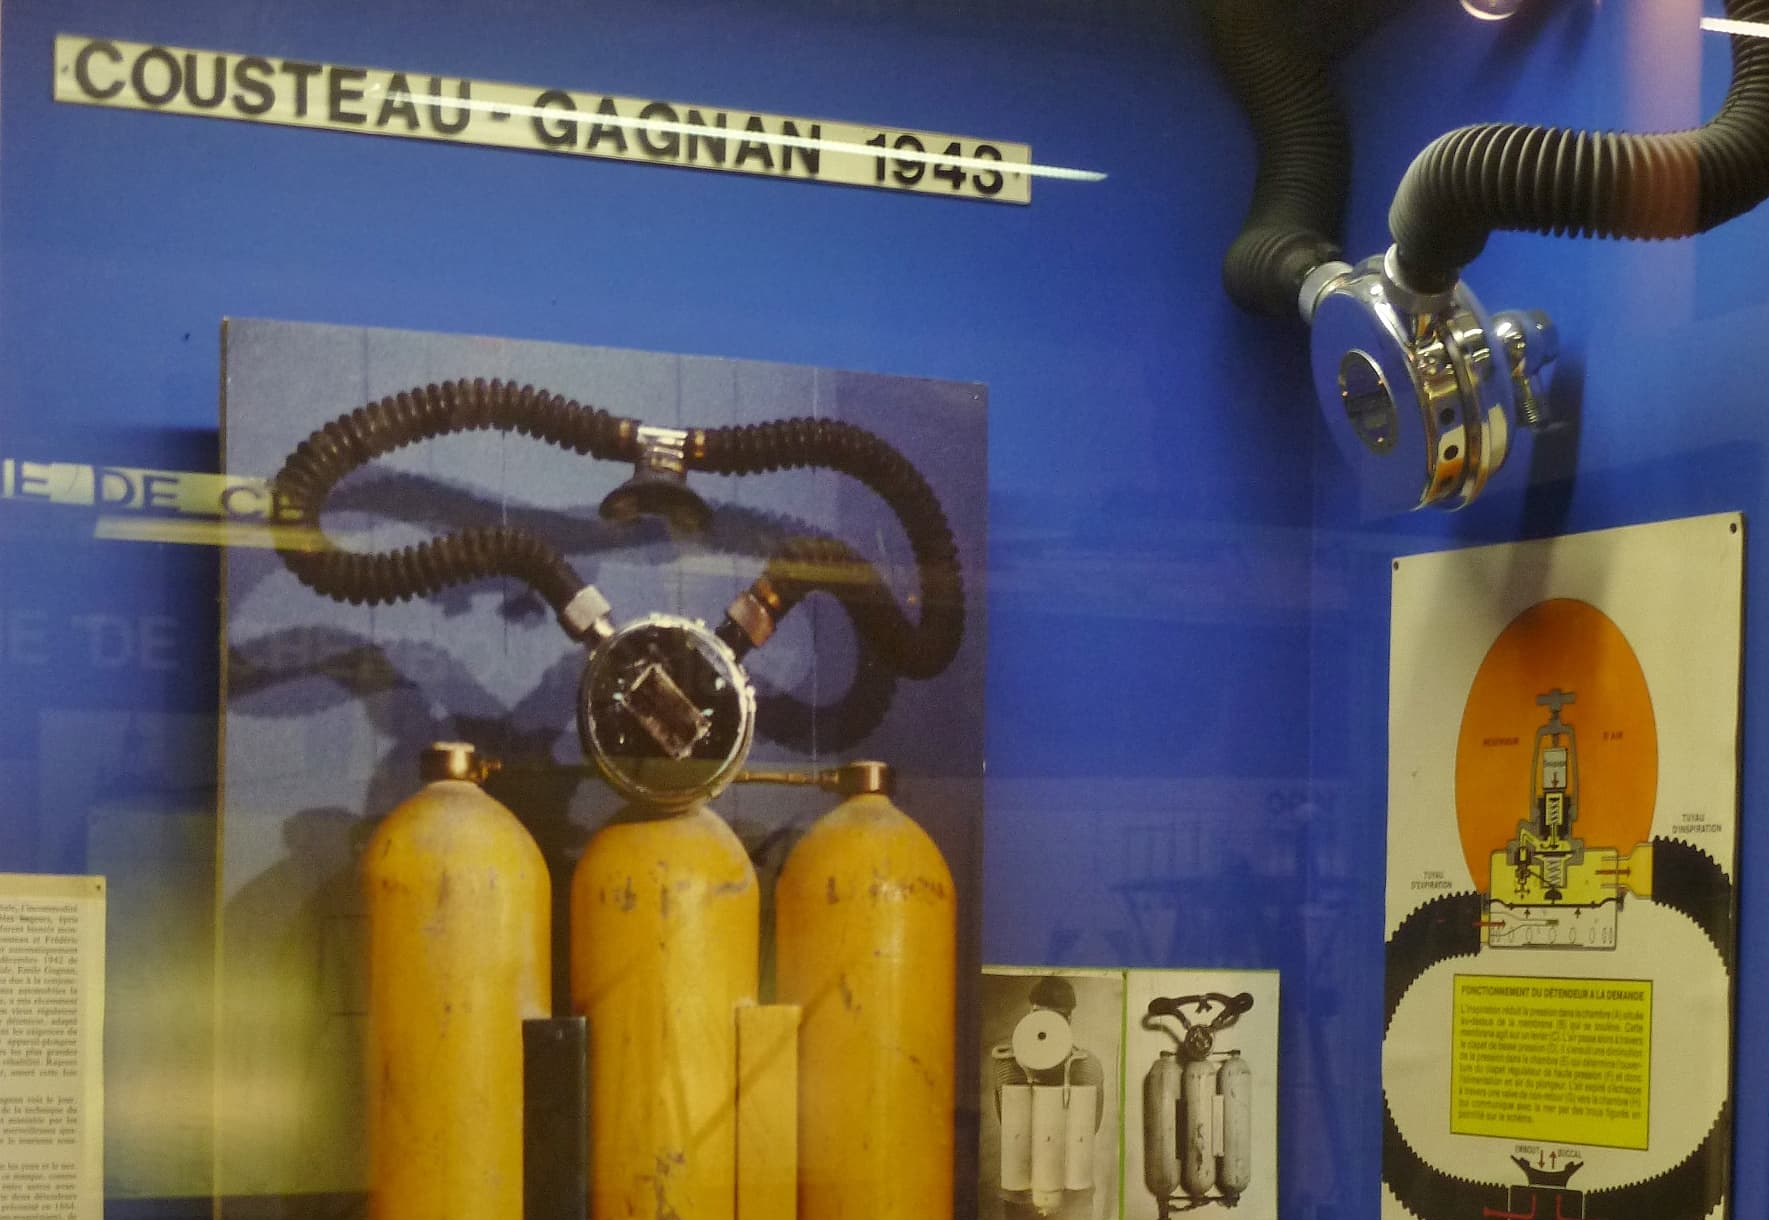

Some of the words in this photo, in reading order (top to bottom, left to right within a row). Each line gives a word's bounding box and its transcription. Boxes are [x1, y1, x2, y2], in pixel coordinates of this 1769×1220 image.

[74, 40, 472, 135] COUSTEAU
[532, 89, 822, 175] GAGNAN
[865, 132, 1004, 197] 1943
